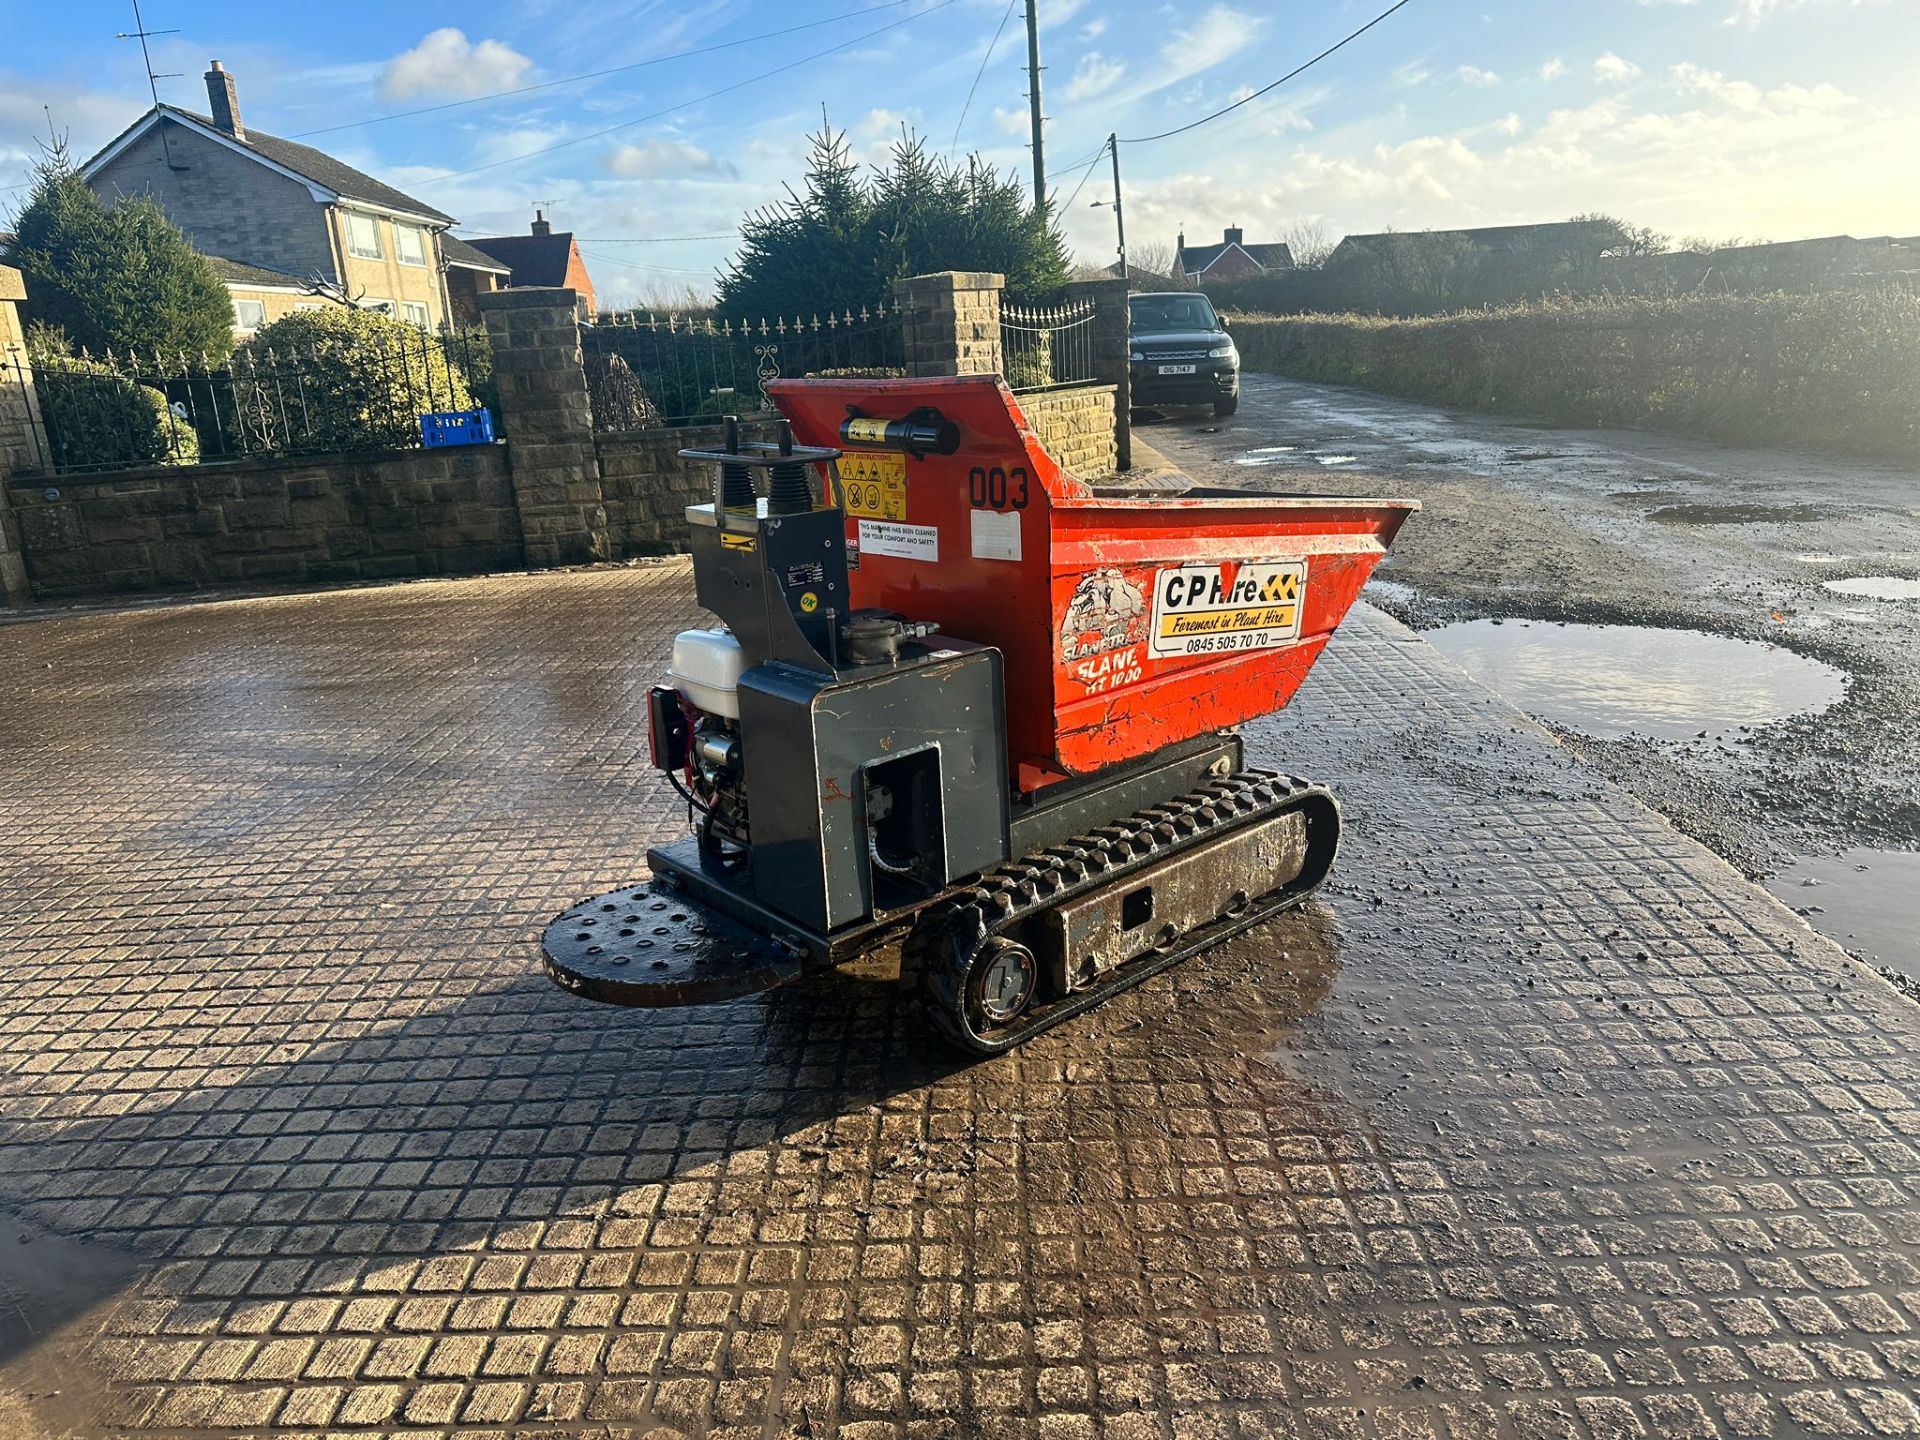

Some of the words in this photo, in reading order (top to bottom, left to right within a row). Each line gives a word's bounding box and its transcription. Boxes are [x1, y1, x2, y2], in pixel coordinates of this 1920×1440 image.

[855, 453, 892, 461] INSTRUCTIONS
[969, 467, 1029, 509] 003
[860, 522, 869, 530] THIS
[915, 529, 936, 537] CLEANED
[872, 533, 884, 541] YOUR
[884, 535, 906, 543] COMFORT
[918, 538, 935, 546] SAFETY
[801, 596, 816, 608] OK
[1172, 616, 1220, 633] Foremost
[1220, 615, 1230, 630] in
[1233, 612, 1261, 628] Plant
[1262, 609, 1285, 625] Hire
[1186, 638, 1214, 653] 0845
[1216, 636, 1237, 650] 505
[1240, 634, 1253, 648] 70
[1255, 633, 1269, 646] 70
[1077, 648, 1138, 678] SLANE
[1110, 666, 1142, 689] 1000
